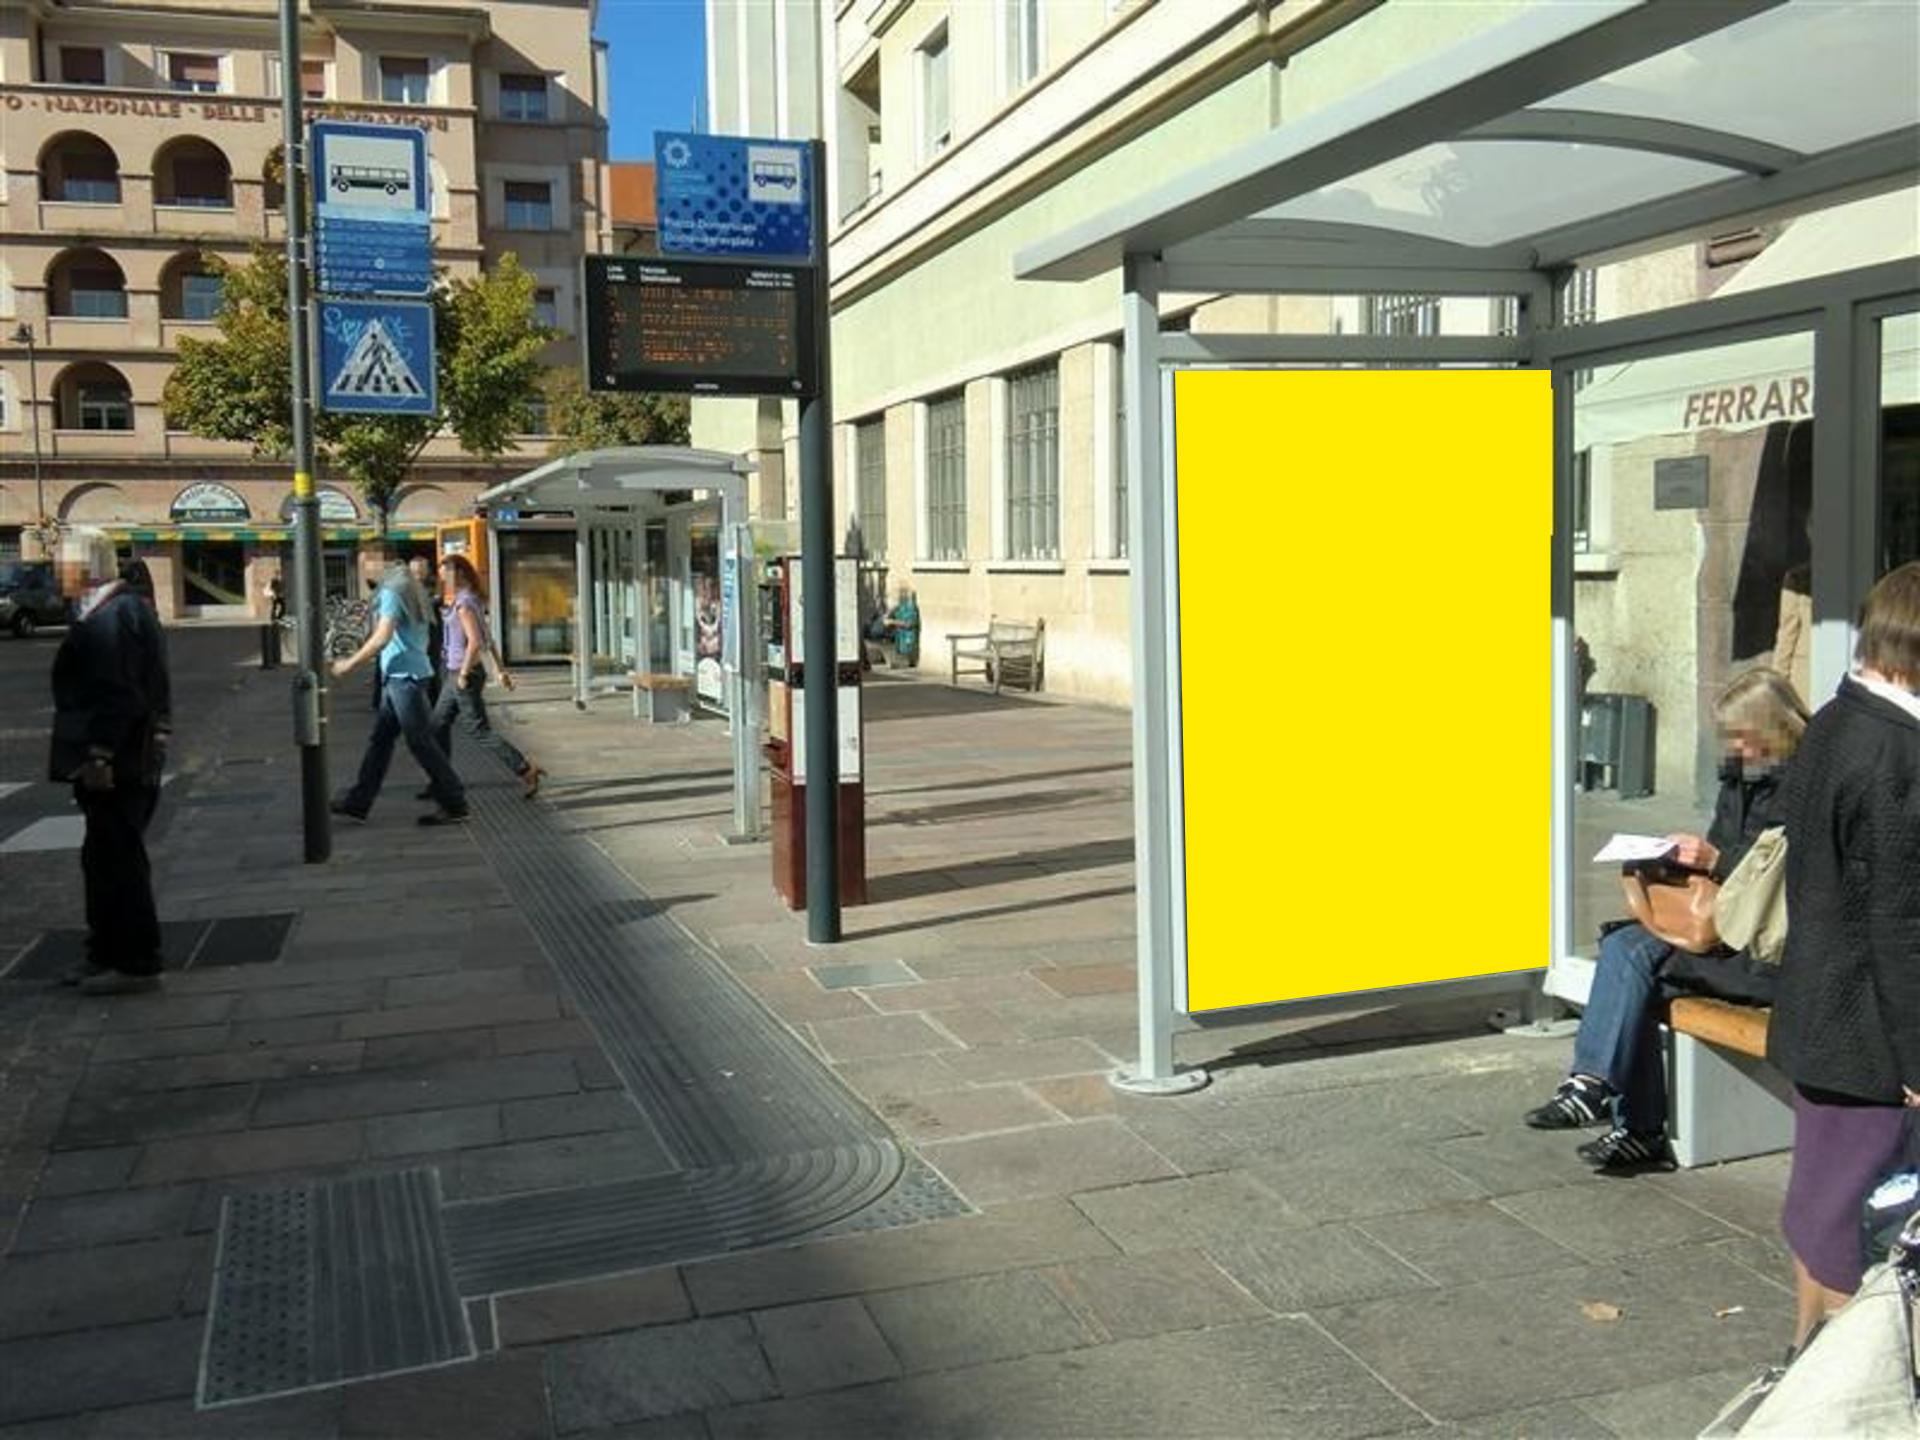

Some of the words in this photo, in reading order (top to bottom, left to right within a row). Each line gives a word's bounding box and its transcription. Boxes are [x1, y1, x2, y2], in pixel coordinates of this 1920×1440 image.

[45, 95, 182, 119] NAZIONALE
[203, 104, 265, 123] DELLE
[1684, 376, 1810, 429] FERRAR
